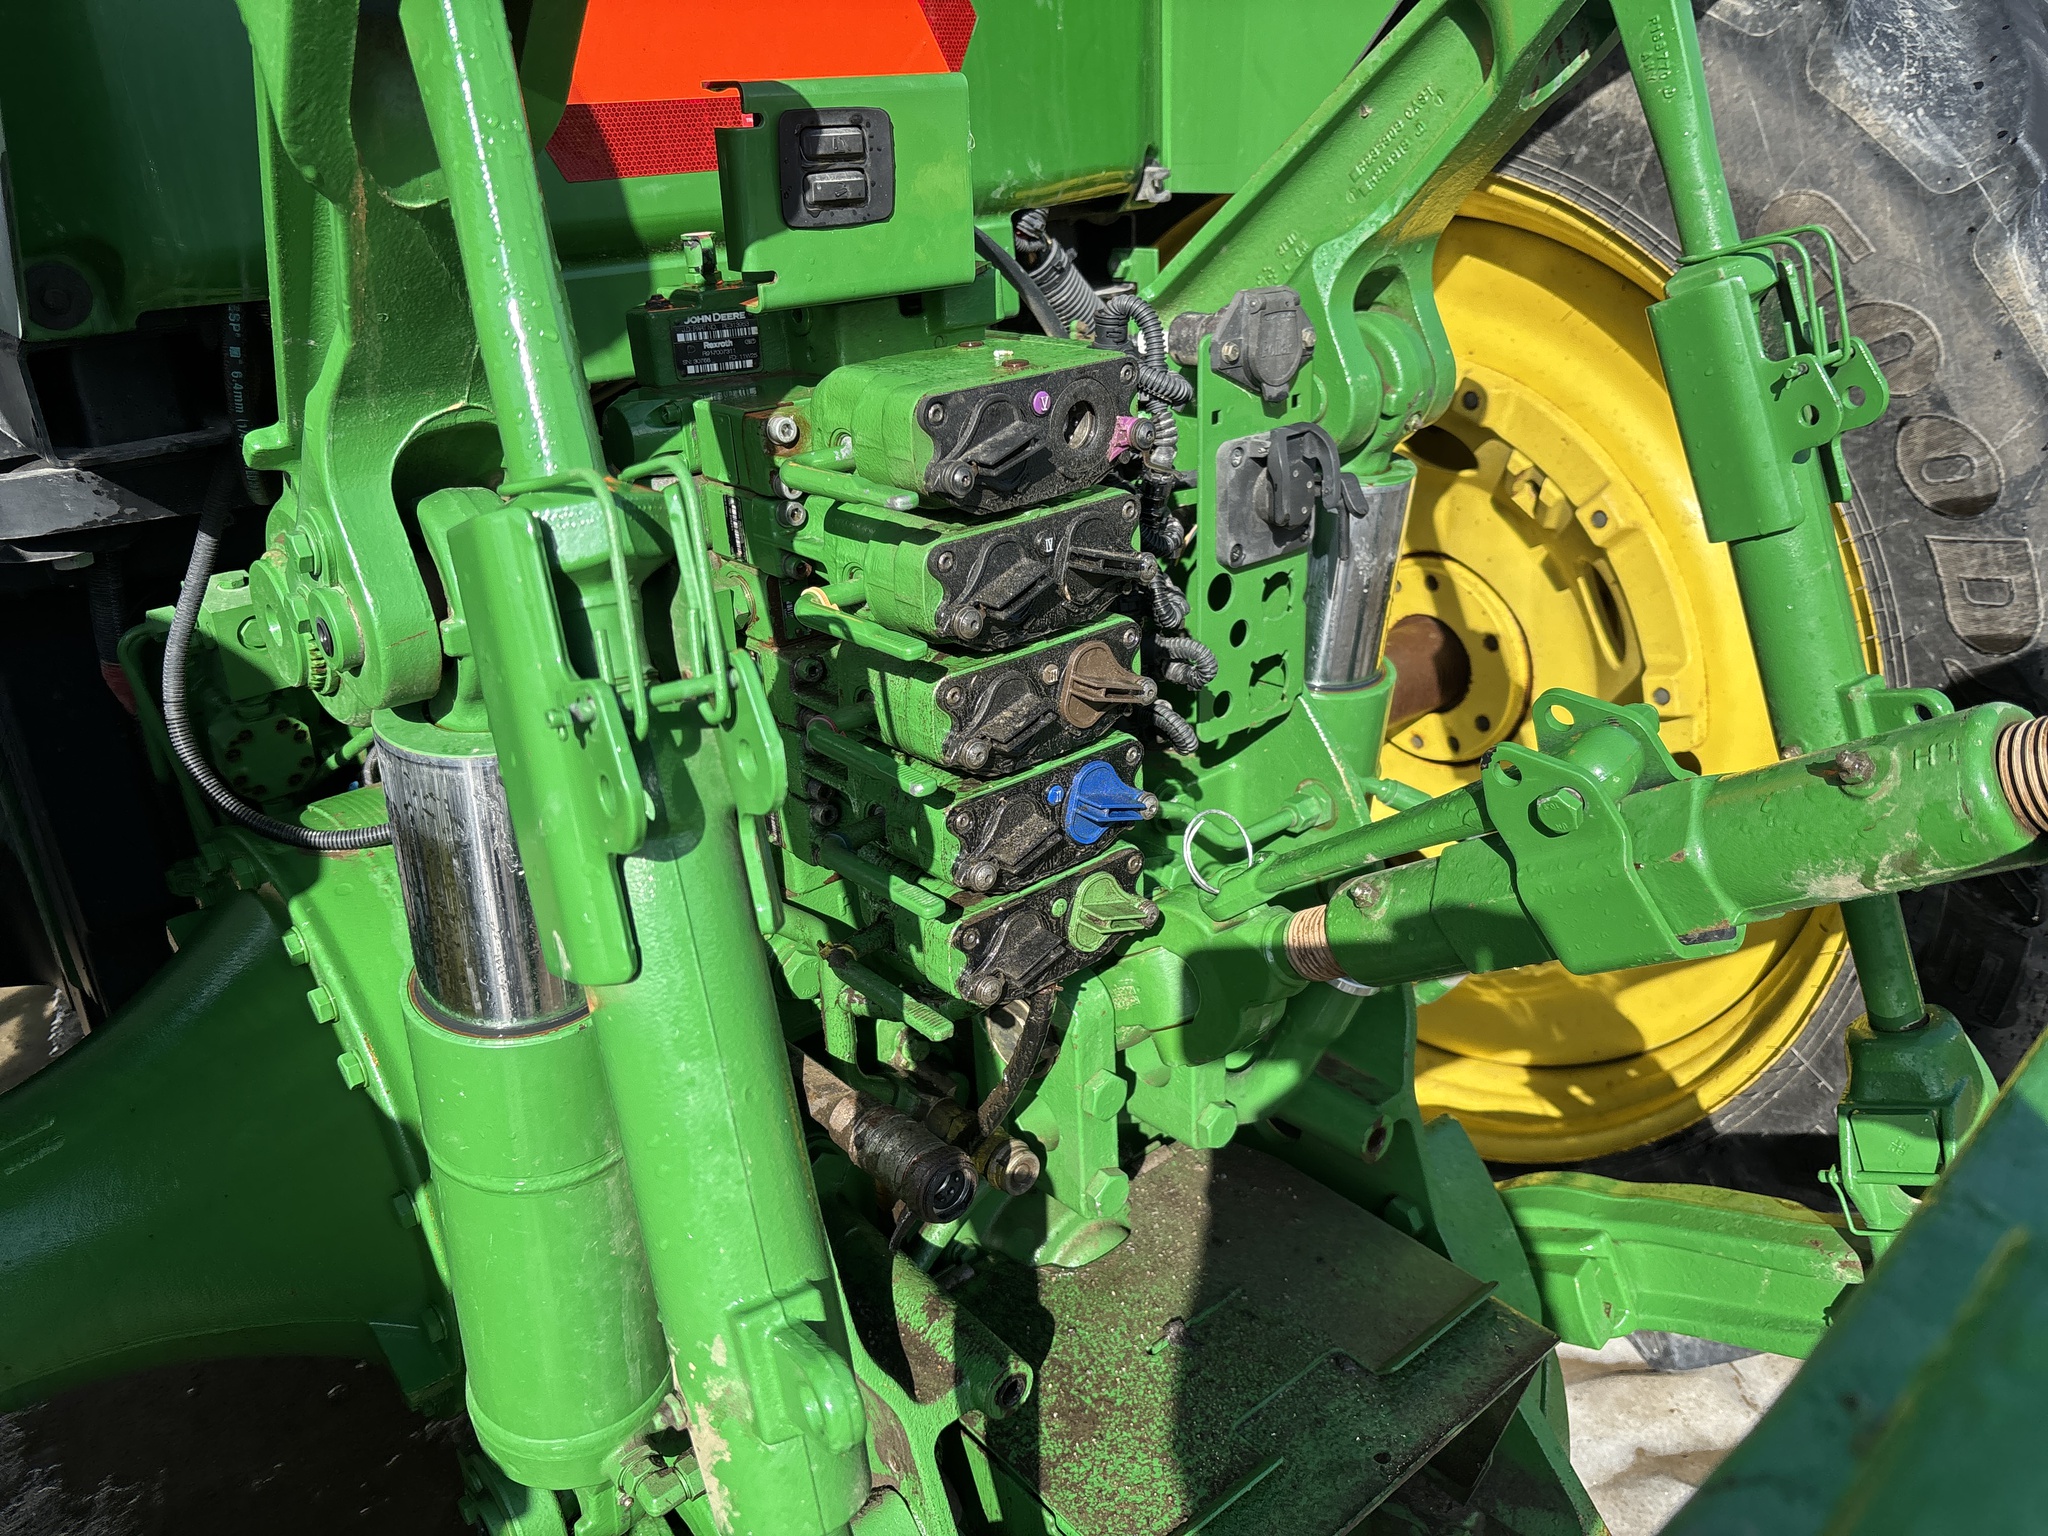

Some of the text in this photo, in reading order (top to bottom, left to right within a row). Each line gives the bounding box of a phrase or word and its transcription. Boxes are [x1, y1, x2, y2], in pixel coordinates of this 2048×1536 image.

[1404, 85, 1435, 120] CAST
[684, 311, 746, 325] JOHN DEERE
[703, 339, 734, 349] Rexroth
[1040, 396, 1049, 411] V
[1045, 537, 1054, 552] IV
